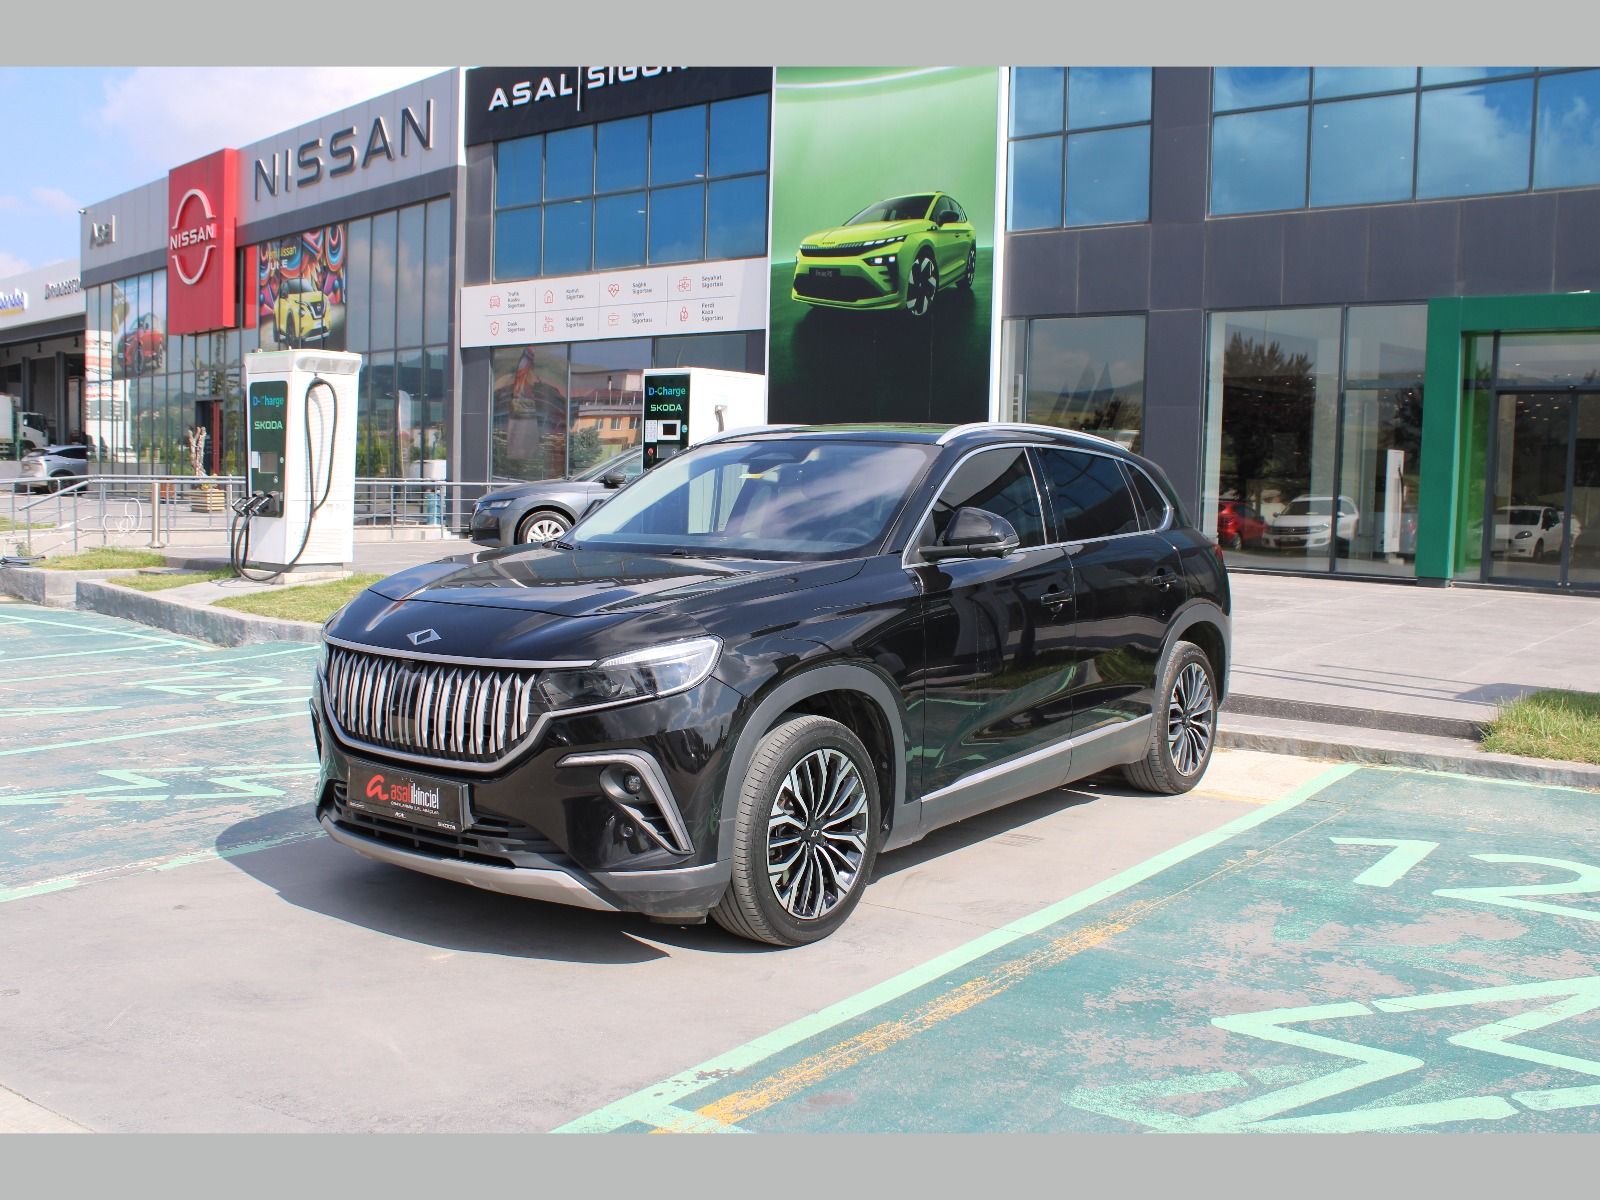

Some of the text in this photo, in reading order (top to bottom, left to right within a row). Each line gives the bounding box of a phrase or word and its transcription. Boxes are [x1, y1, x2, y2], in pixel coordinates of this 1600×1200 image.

[488, 73, 573, 112] ASAL
[254, 98, 435, 201] NISSAN
[170, 223, 217, 250] NISSAN
[253, 395, 285, 408] D-harge
[648, 386, 686, 397] D-Charge
